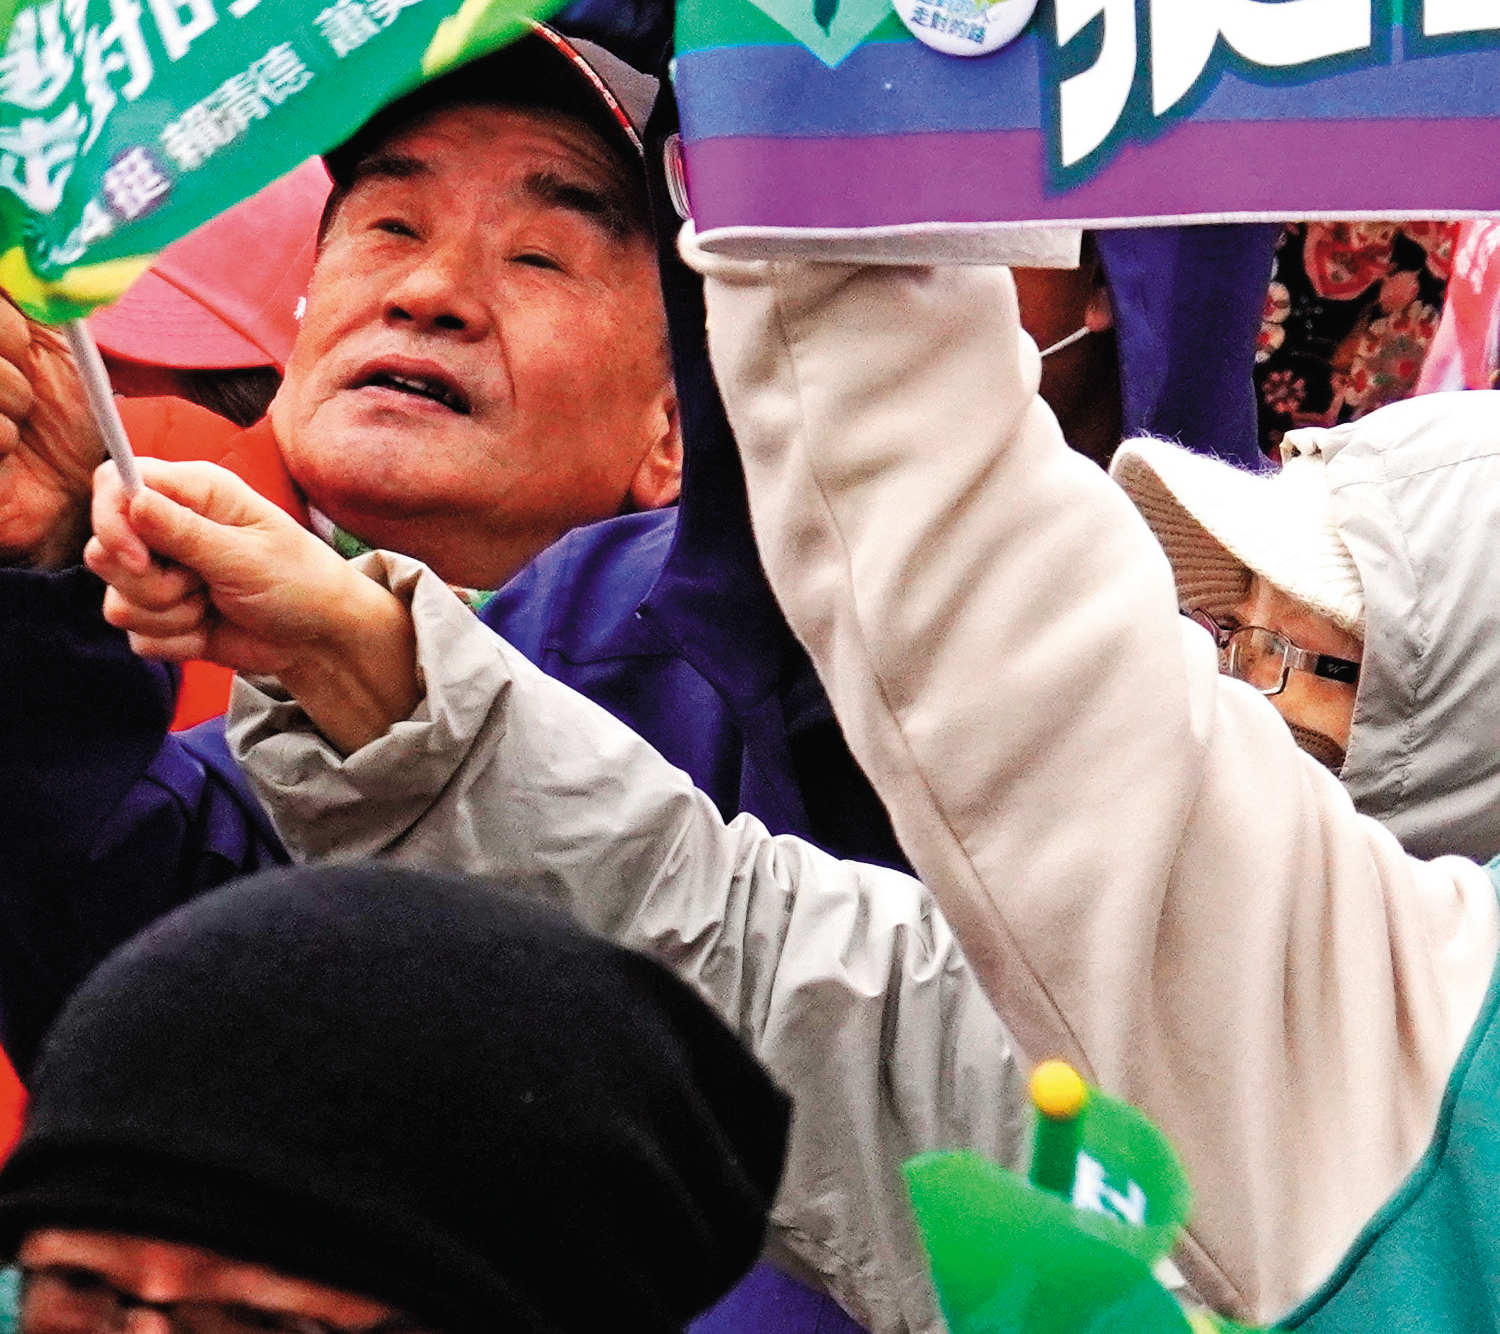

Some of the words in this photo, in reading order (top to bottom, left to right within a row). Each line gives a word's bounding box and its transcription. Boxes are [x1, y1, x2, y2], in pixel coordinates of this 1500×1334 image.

[102, 143, 175, 223] 挺
[161, 42, 311, 176] 賴清德
